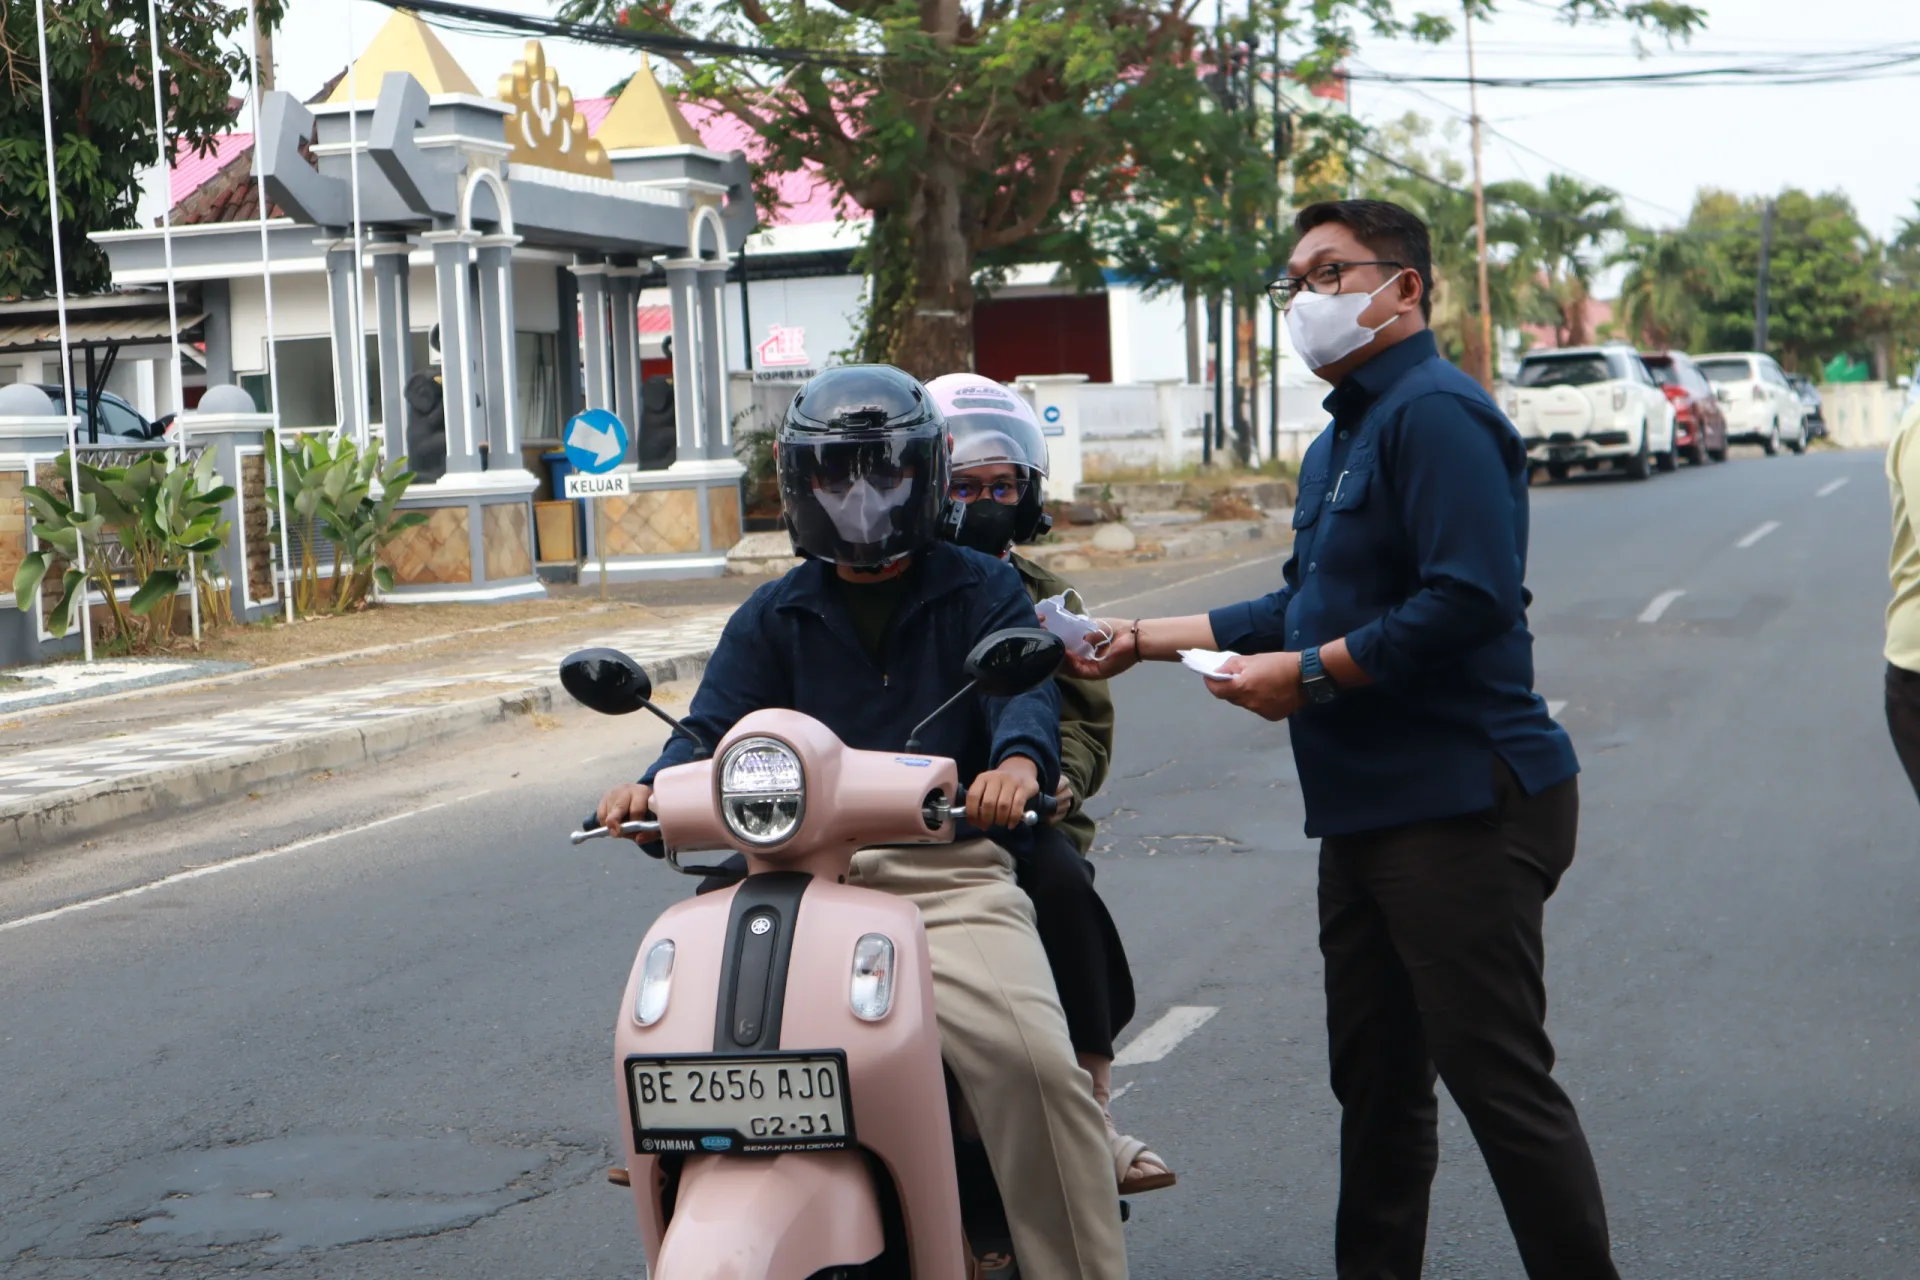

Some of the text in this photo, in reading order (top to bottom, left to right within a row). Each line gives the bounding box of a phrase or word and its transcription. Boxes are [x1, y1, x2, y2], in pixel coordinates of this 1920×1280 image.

[570, 479, 623, 493] KELUAR
[639, 1071, 677, 1104] BE
[687, 1069, 764, 1103] 2656
[654, 1139, 696, 1151] YAMAHA
[743, 1143, 793, 1152] SEMAKIN
[806, 1141, 845, 1150] DEPAN
